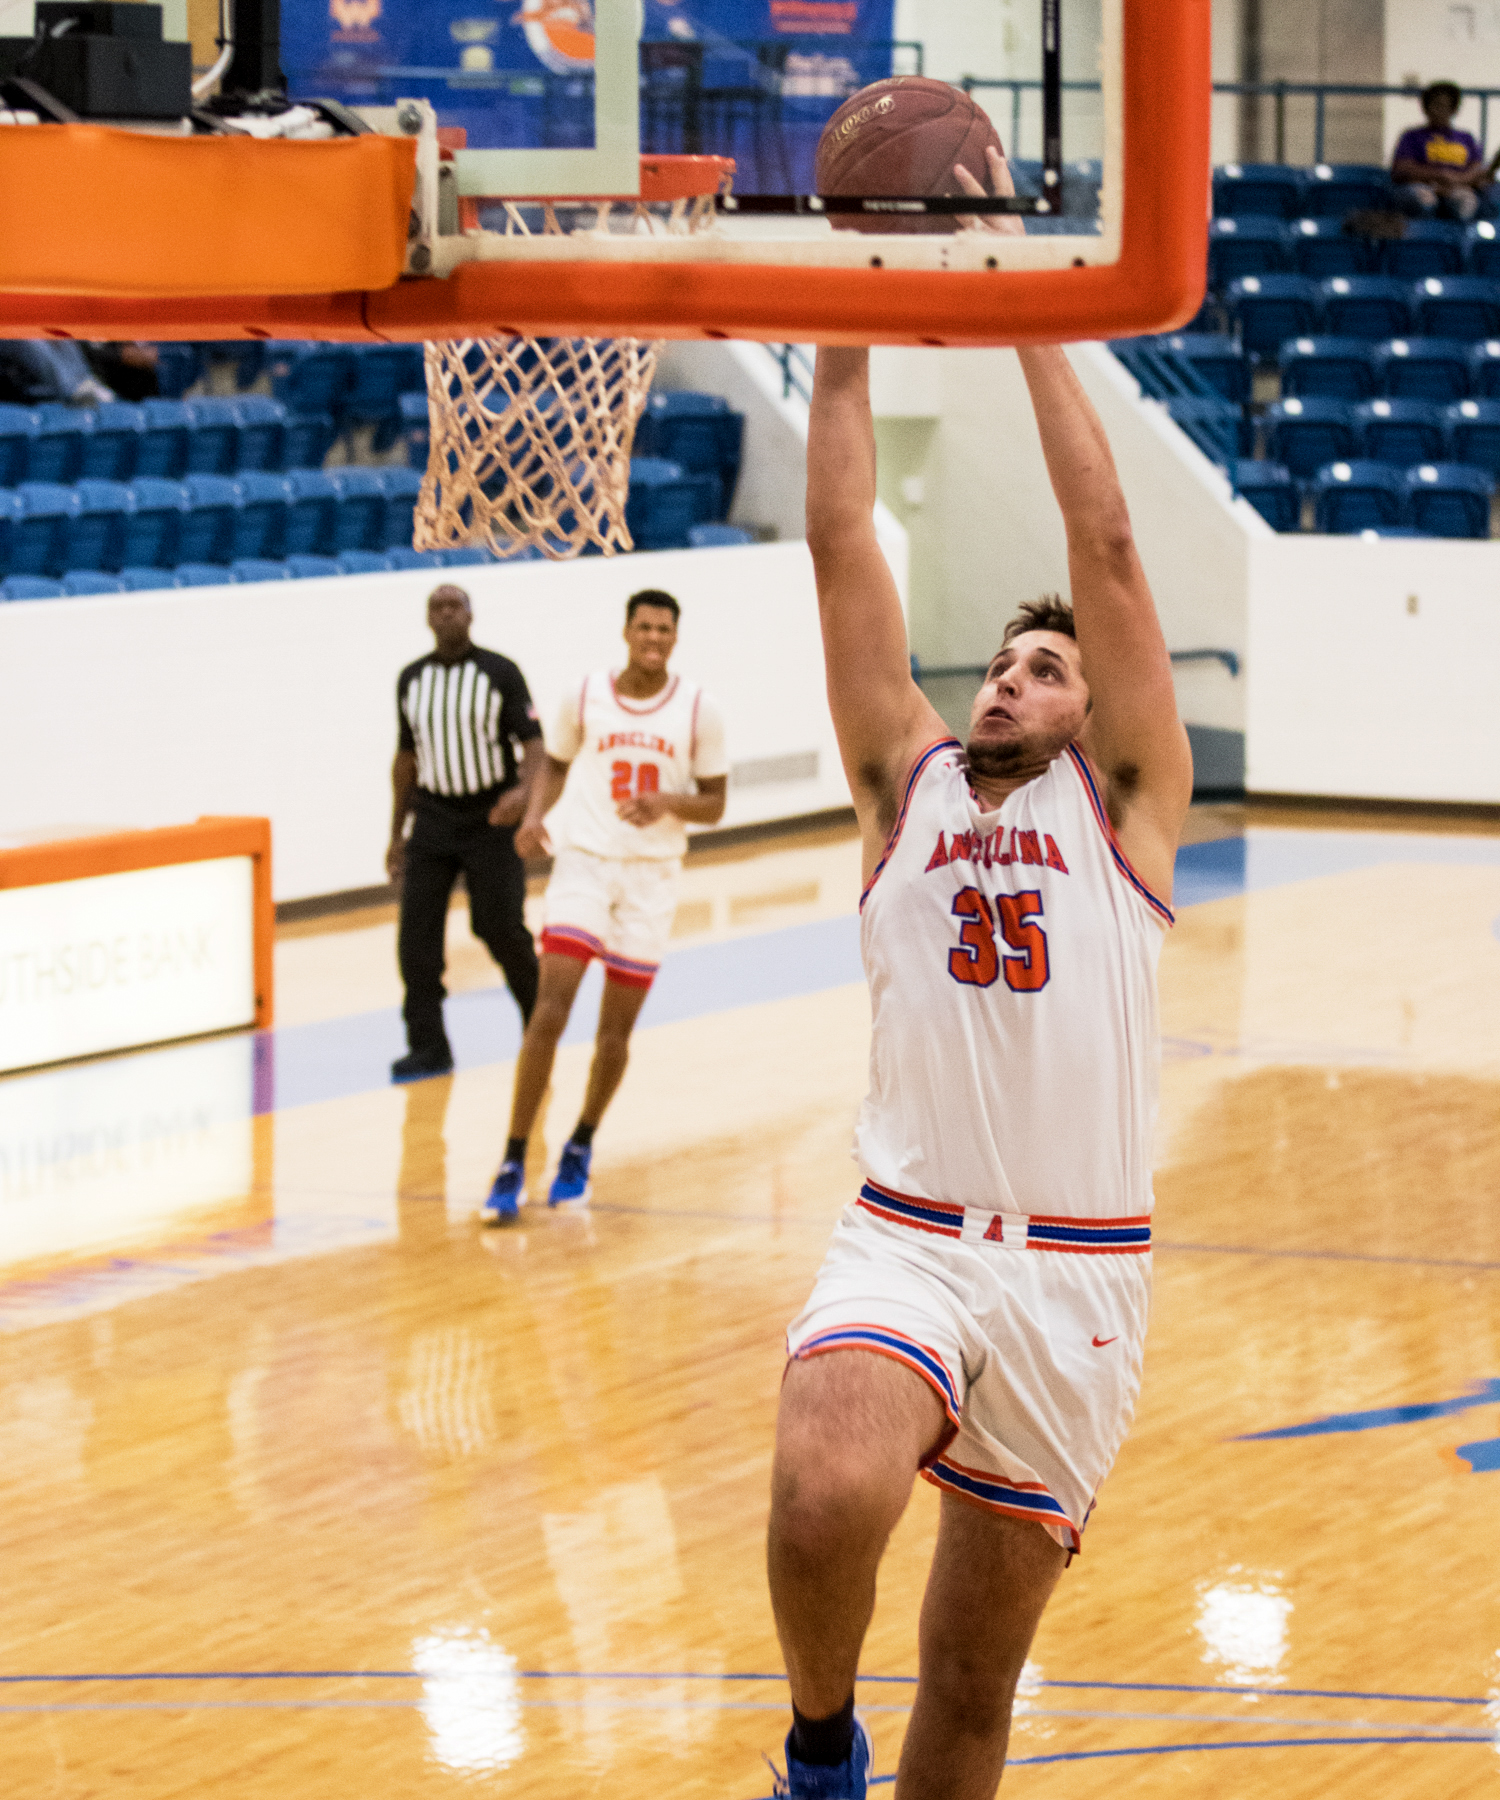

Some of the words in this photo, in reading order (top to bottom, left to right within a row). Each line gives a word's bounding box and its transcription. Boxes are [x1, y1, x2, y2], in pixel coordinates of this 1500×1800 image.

[611, 761, 659, 800] 20
[139, 922, 217, 980] BANK
[948, 885, 1051, 993] 35
[983, 1214, 1004, 1242] A
